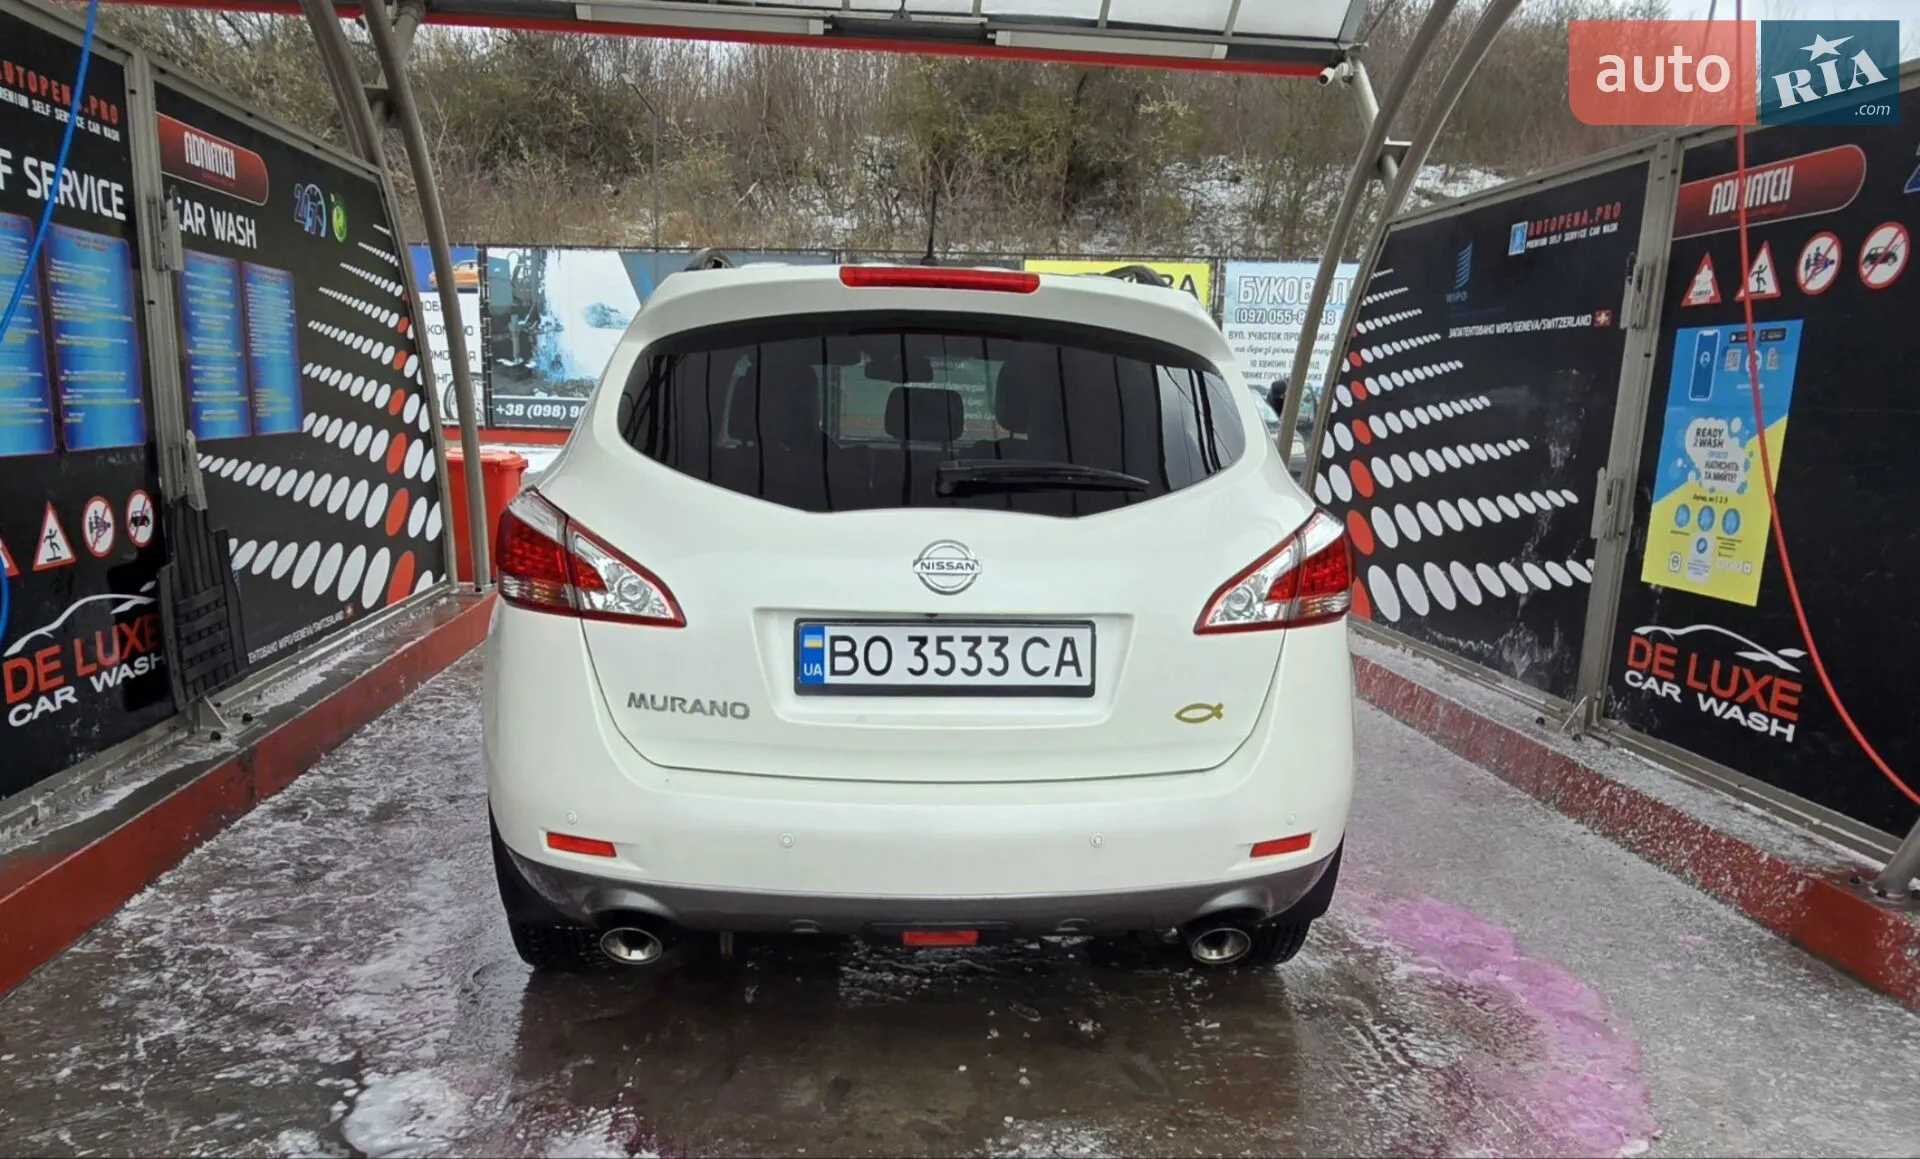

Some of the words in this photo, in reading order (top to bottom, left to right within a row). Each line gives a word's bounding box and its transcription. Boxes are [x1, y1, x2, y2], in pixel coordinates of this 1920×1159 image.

[0, 60, 119, 125] UTOPEN.PRO
[23, 156, 126, 221] SERVICE
[176, 196, 207, 237] AR
[210, 206, 257, 249] WASH
[1237, 275, 1351, 306] БУКОВЛ
[1234, 307, 1267, 325] (097)
[496, 403, 525, 417] +38
[526, 404, 567, 420] (098)
[1695, 427, 1724, 438] READY
[920, 561, 975, 571] NISSAN
[3, 643, 65, 704] DE
[73, 614, 161, 678] LUXE
[803, 663, 823, 676] UA
[829, 635, 893, 677] BO
[906, 635, 1010, 677] 3533
[1021, 636, 1083, 678] CA
[1627, 635, 1678, 681] DE
[1686, 652, 1803, 721] LUXE
[8, 686, 78, 727] CAR
[627, 692, 750, 720] MURANO
[1624, 670, 1682, 703] CAR
[1697, 692, 1796, 743] WASH
